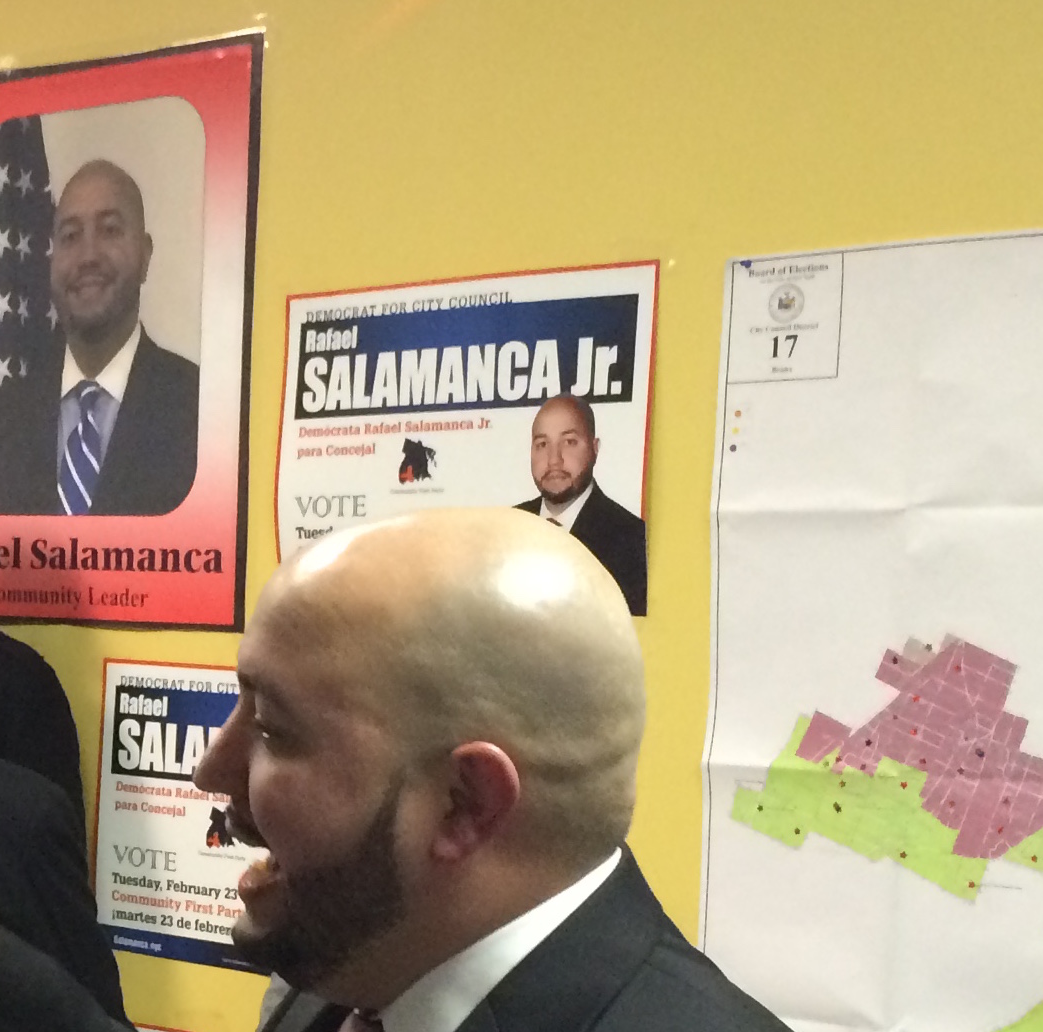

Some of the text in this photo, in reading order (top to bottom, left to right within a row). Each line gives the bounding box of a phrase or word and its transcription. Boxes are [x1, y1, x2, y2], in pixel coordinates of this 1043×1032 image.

[306, 291, 513, 323] DEMOCRAT FOR CITY COUNCIL
[305, 325, 358, 353] Rafael
[772, 334, 799, 359] 17
[302, 337, 622, 413] SALAMANCA Jr.
[364, 421, 401, 435] Rafael
[405, 418, 473, 433] Salamanca
[297, 443, 376, 460] para Concejal
[294, 494, 367, 518] VOTE
[30, 537, 223, 574] Salamanca
[88, 586, 149, 609] Leader
[120, 675, 240, 694] DEMOCRAT FOR CIT
[119, 692, 169, 717] Rafael
[118, 718, 222, 775] SALA
[175, 787, 210, 801] Rafael
[115, 800, 186, 818] para Concejal
[113, 844, 177, 872] VOTE
[111, 872, 163, 892] Tuesday,
[166, 879, 222, 900] February
[111, 890, 181, 912] Community
[185, 900, 213, 915] First
[112, 909, 157, 925] ¡martes
[160, 914, 173, 927] 23
[176, 917, 192, 930] de
